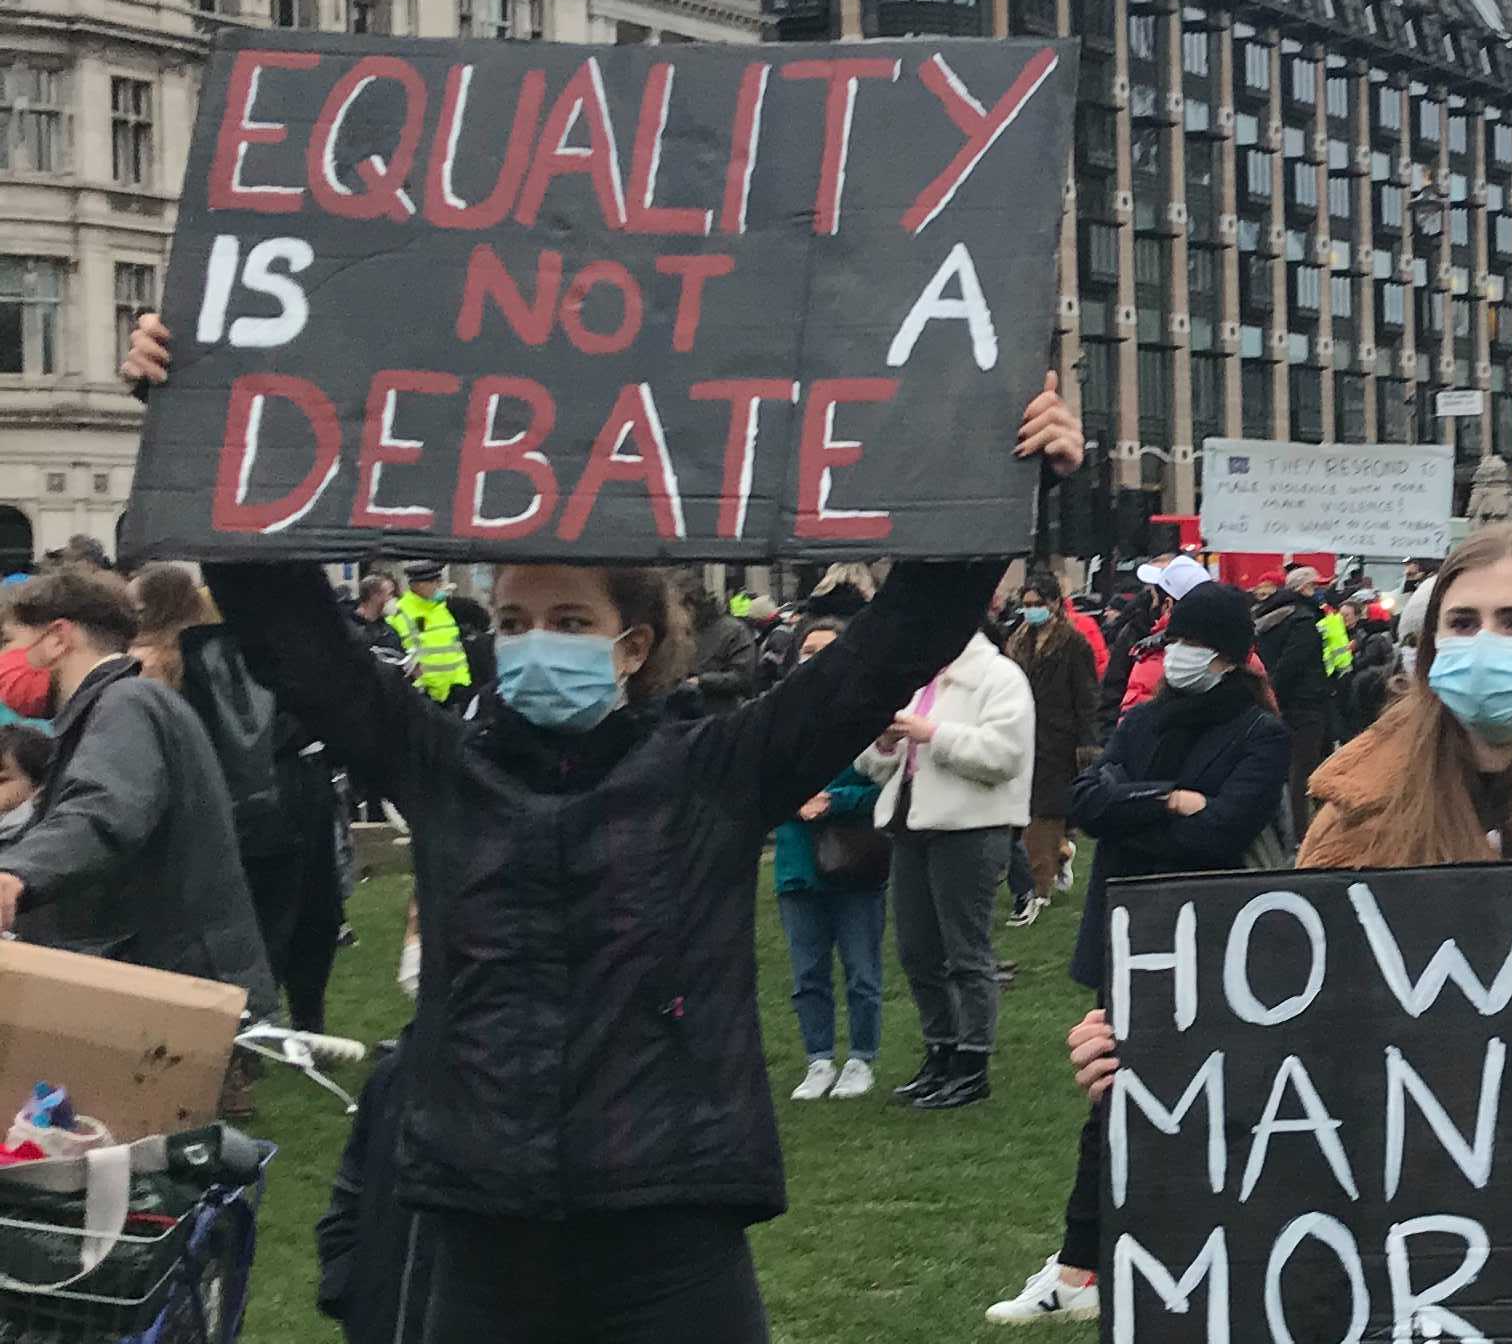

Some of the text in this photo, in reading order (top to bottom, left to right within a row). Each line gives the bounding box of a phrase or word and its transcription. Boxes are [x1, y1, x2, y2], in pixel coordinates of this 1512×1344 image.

[208, 48, 1059, 236] EQUALITY
[195, 233, 999, 370] IS NOT A
[211, 370, 902, 542] DEBATE
